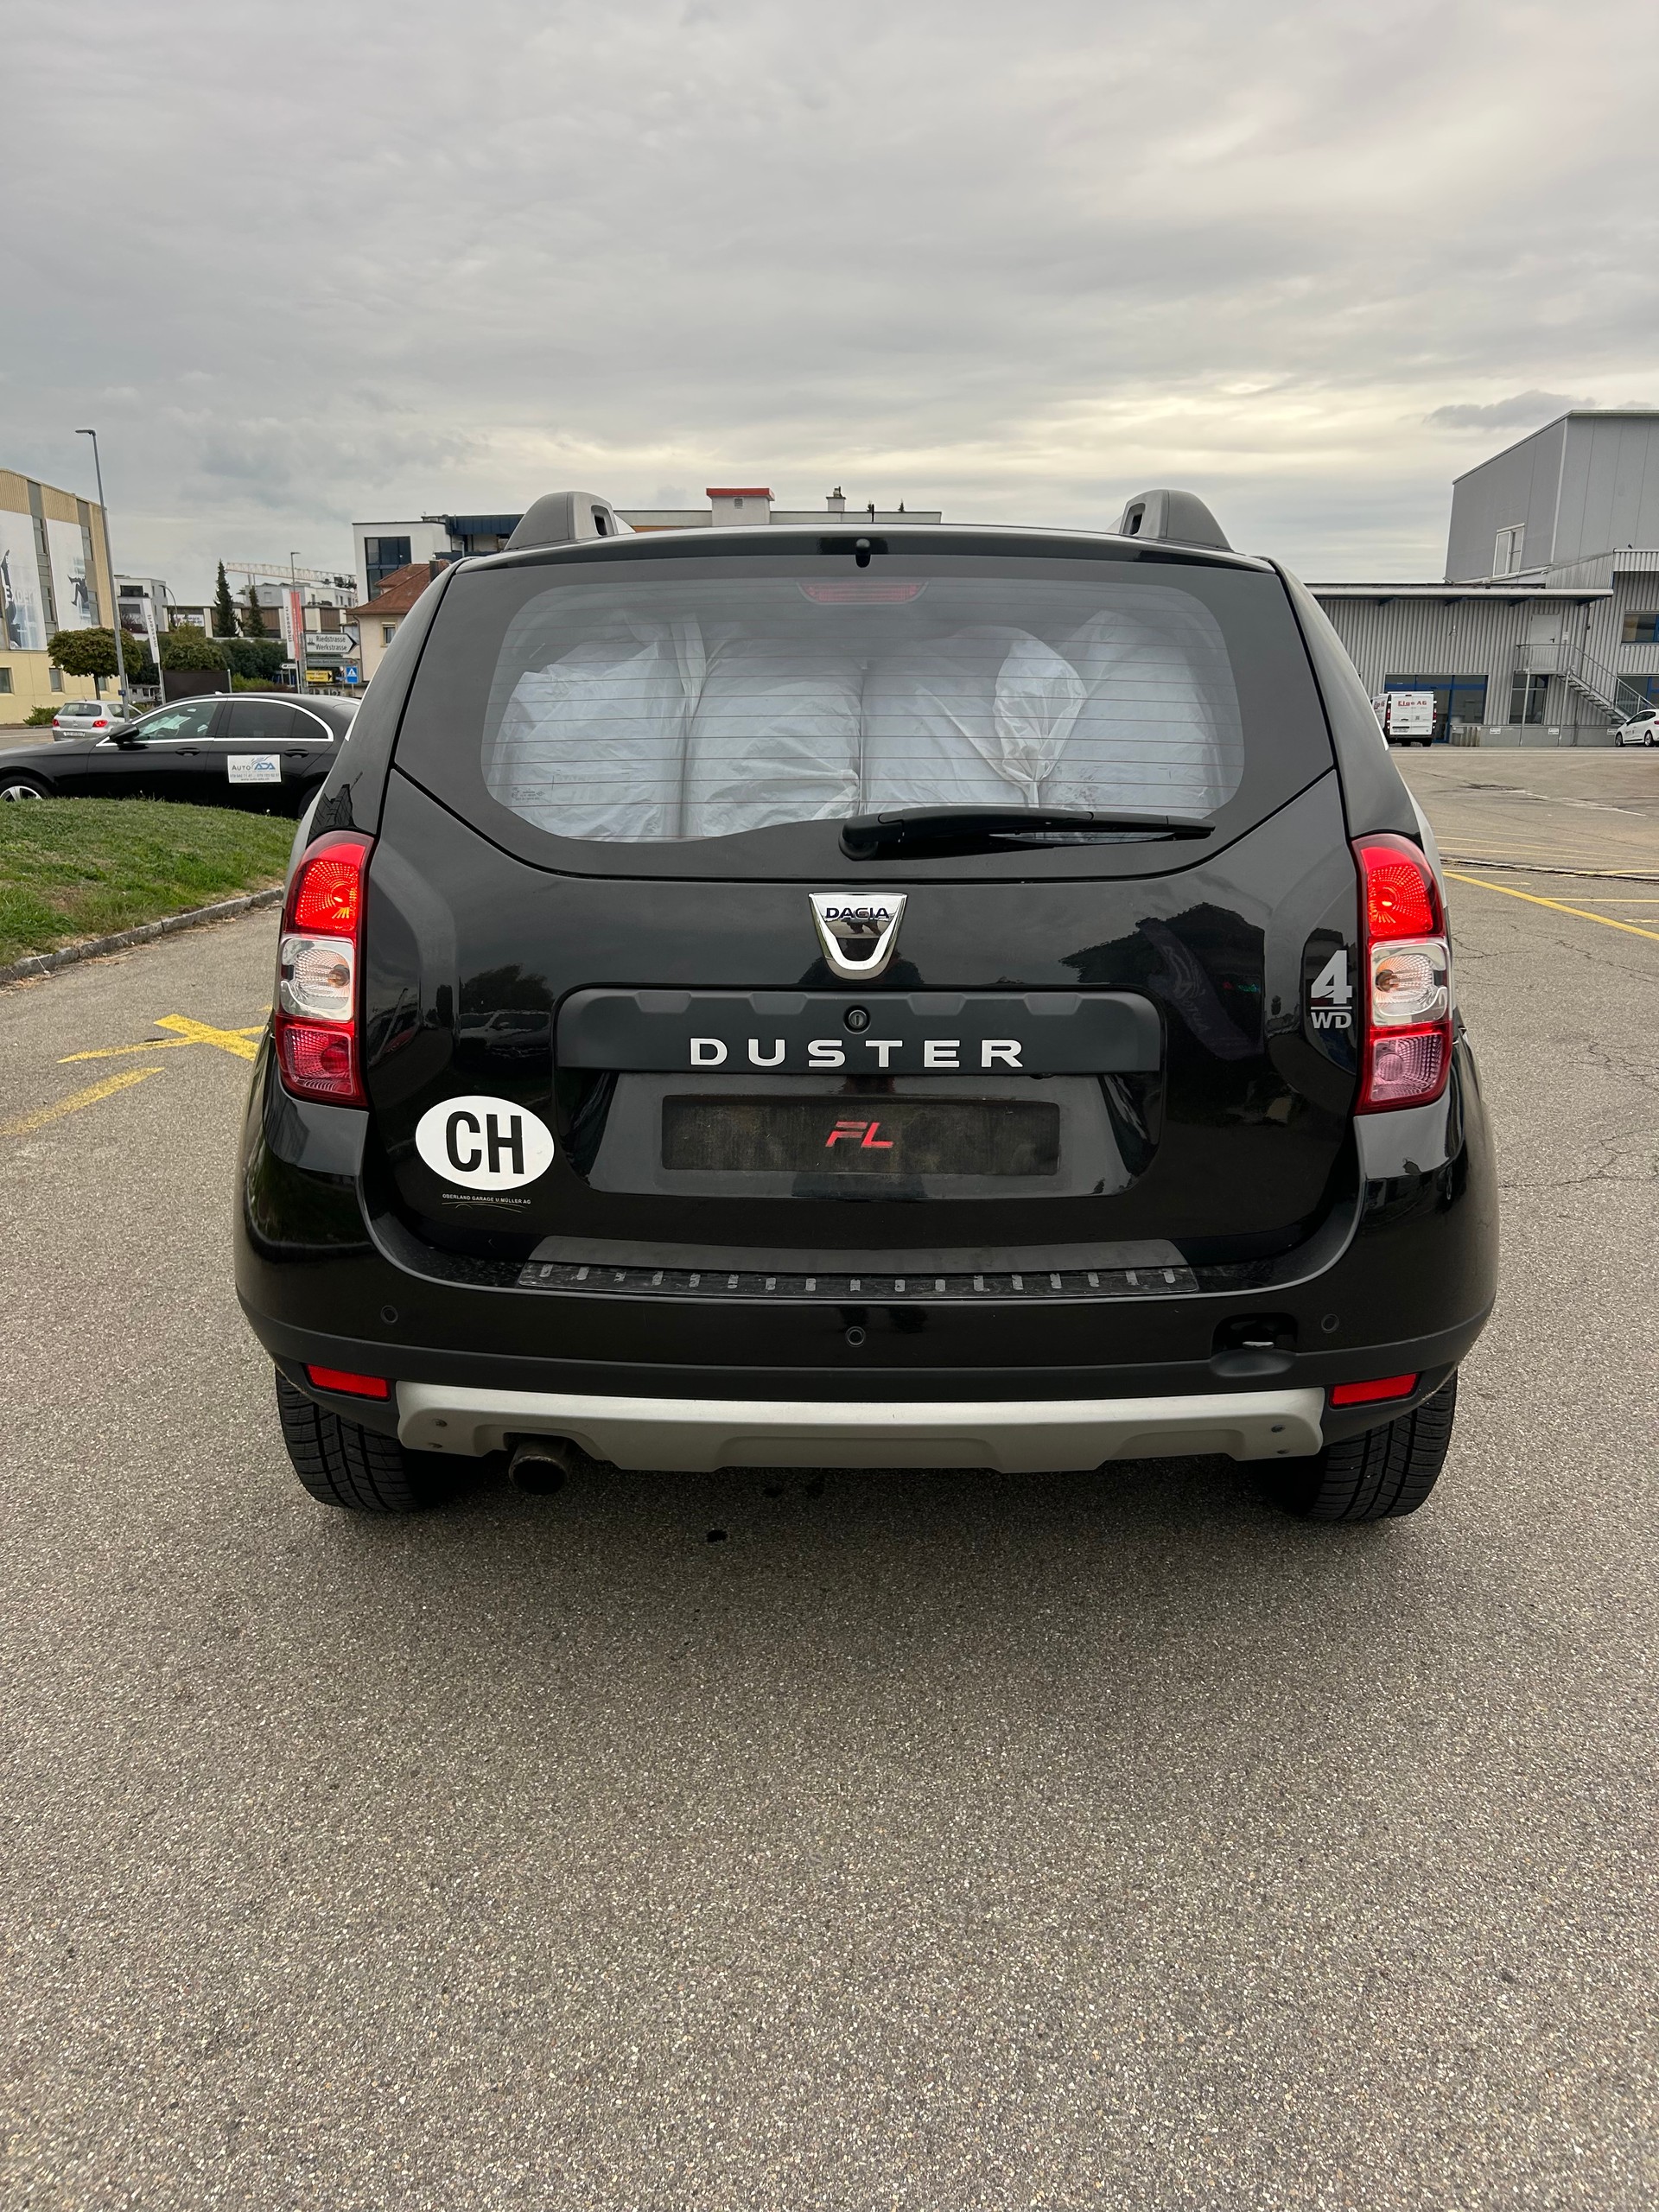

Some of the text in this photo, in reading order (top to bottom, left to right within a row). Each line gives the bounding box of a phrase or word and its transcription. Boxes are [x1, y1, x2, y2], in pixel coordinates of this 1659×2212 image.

[825, 906, 890, 919] DACIA
[1311, 950, 1352, 1004] 4
[1310, 1011, 1352, 1029] WD
[690, 1038, 1024, 1068] DUSTER
[446, 1110, 524, 1174] CH
[825, 1121, 893, 1149] FL
